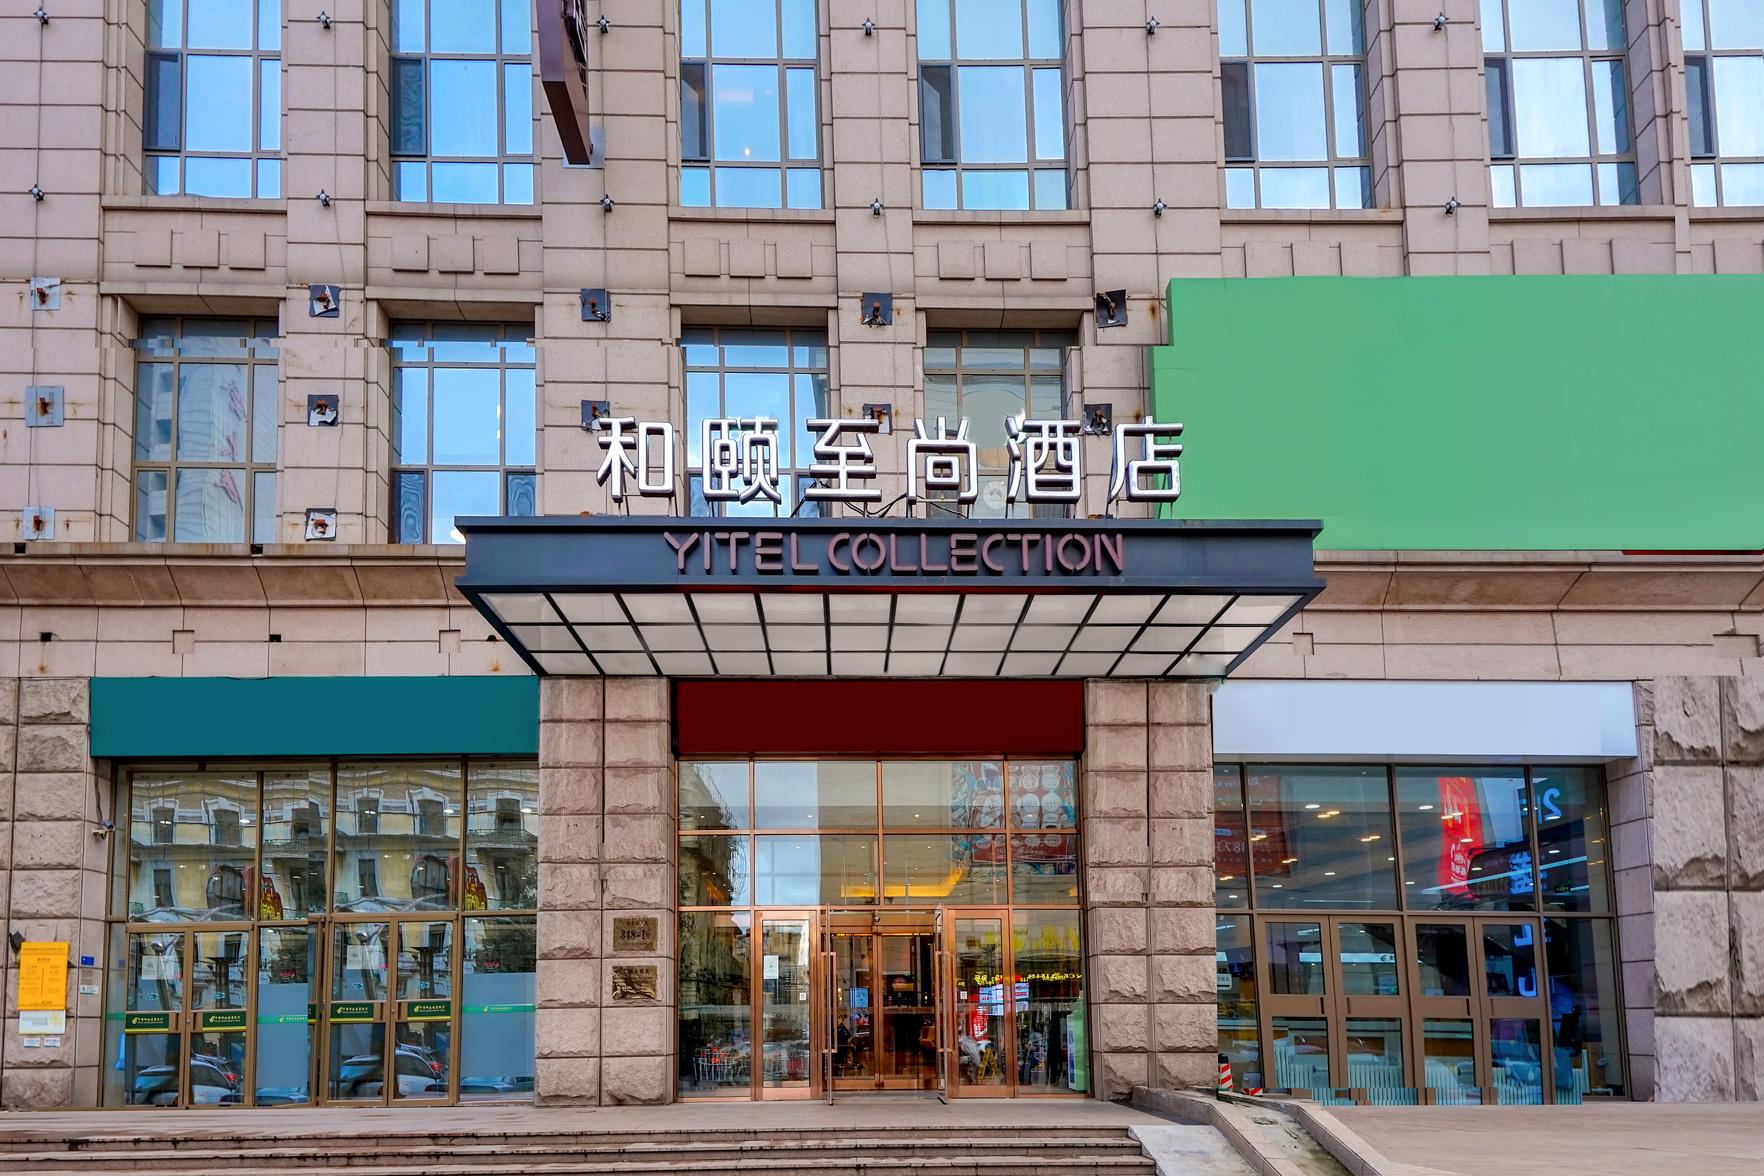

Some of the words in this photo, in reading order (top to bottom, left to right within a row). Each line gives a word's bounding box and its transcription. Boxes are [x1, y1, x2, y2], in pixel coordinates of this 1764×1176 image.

[596, 415, 1185, 503] 和颐至尚酒店
[662, 531, 819, 575] YITEL
[827, 531, 1127, 576] COLLECTION
